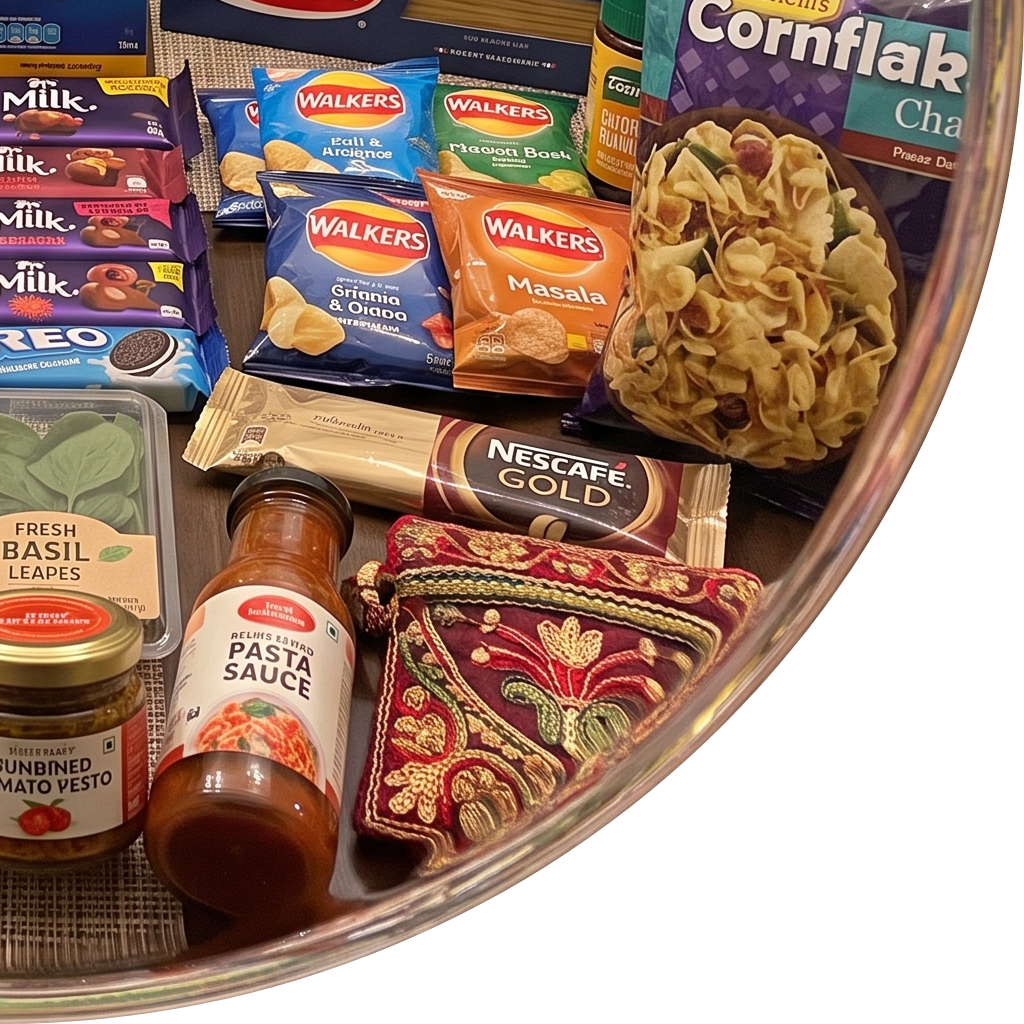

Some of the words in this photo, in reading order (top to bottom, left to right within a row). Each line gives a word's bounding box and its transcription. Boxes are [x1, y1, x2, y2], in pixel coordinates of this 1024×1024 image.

[298, 91, 402, 109] WALKERS
[447, 97, 549, 120] WALKERS
[309, 214, 426, 251] WALKERS
[485, 215, 600, 254] WALKERS
[507, 274, 608, 306] Masala
[328, 298, 344, 312] &
[499, 468, 612, 508] GOLD
[15, 522, 76, 538] FRESH
[2, 541, 90, 562] BASIL
[9, 565, 81, 581] LEAPES
[228, 641, 312, 679] PASTA
[223, 662, 311, 701] SAUCE
